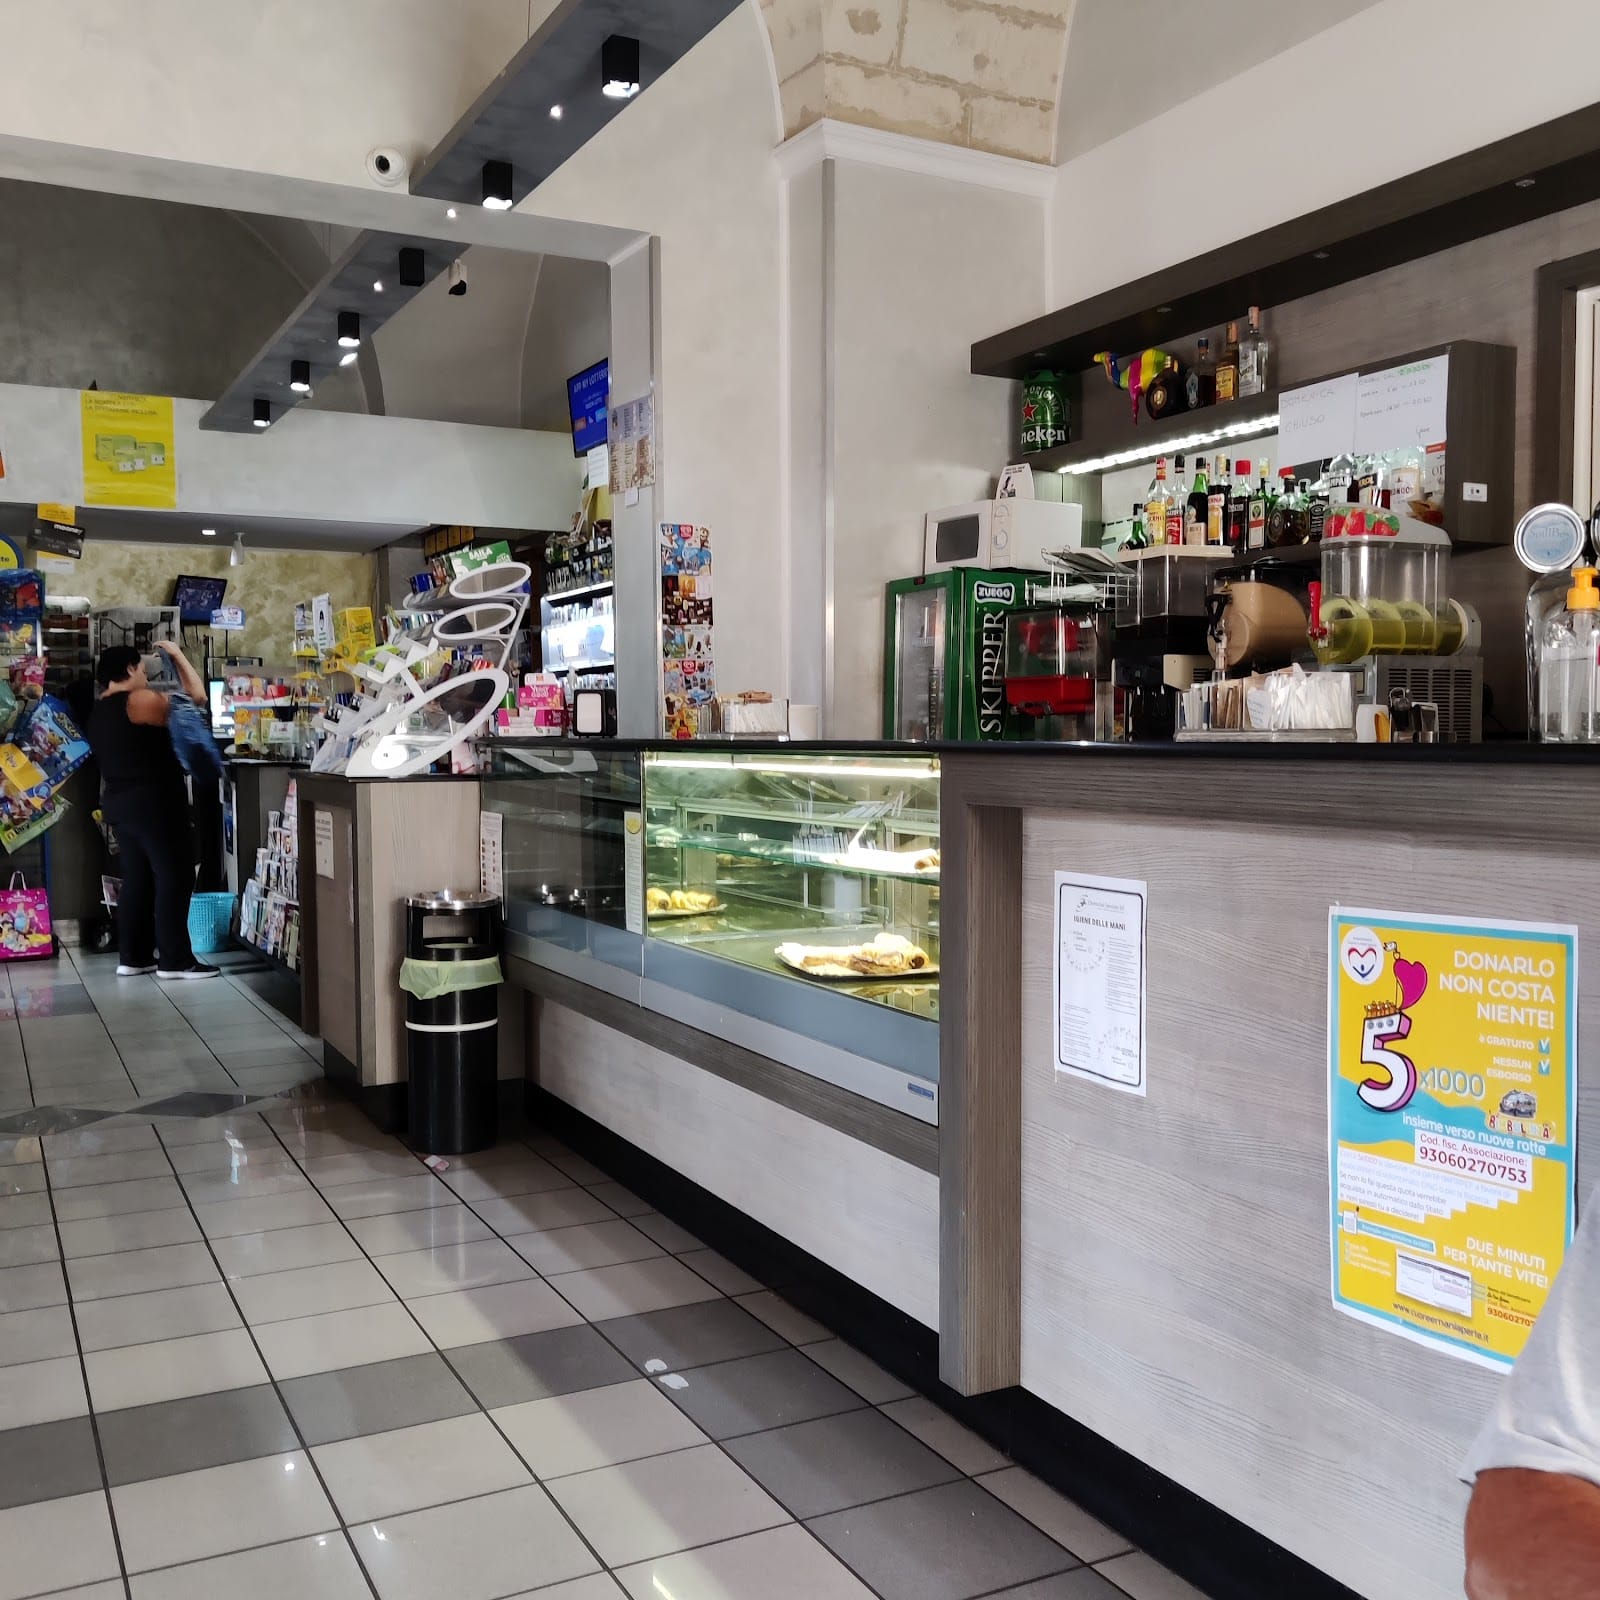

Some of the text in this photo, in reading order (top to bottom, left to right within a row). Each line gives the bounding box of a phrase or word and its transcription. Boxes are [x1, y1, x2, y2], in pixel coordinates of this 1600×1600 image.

[1284, 414, 1325, 433] CHIUSO
[977, 586, 1011, 599] ZUEGG
[979, 610, 1007, 734] SKIPPER
[1091, 917, 1109, 929] DELLE
[1109, 919, 1126, 931] MANI
[1453, 949, 1556, 978] DONARLO
[1439, 973, 1556, 1004] NON COSTA
[1476, 1001, 1555, 1030] NIENTE!
[1486, 1035, 1535, 1051] GRATUITO
[1357, 1013, 1486, 1112] 5 x1000
[1486, 1067, 1532, 1084] ESBORSO
[1492, 1055, 1532, 1070] NESSUN
[1419, 1133, 1441, 1147] Cod.
[1460, 1141, 1528, 1167] Associazione:
[1445, 1125, 1476, 1141] verso
[1478, 1131, 1515, 1149] nuove
[1516, 1139, 1547, 1156] rotte
[1419, 1146, 1528, 1184] 93060270753
[1375, 1180, 1397, 1193] questa
[1397, 1185, 1416, 1197] quota
[1443, 1245, 1549, 1289] PER TANTE VITE!
[1466, 1236, 1546, 1271] DUE MINUTI
